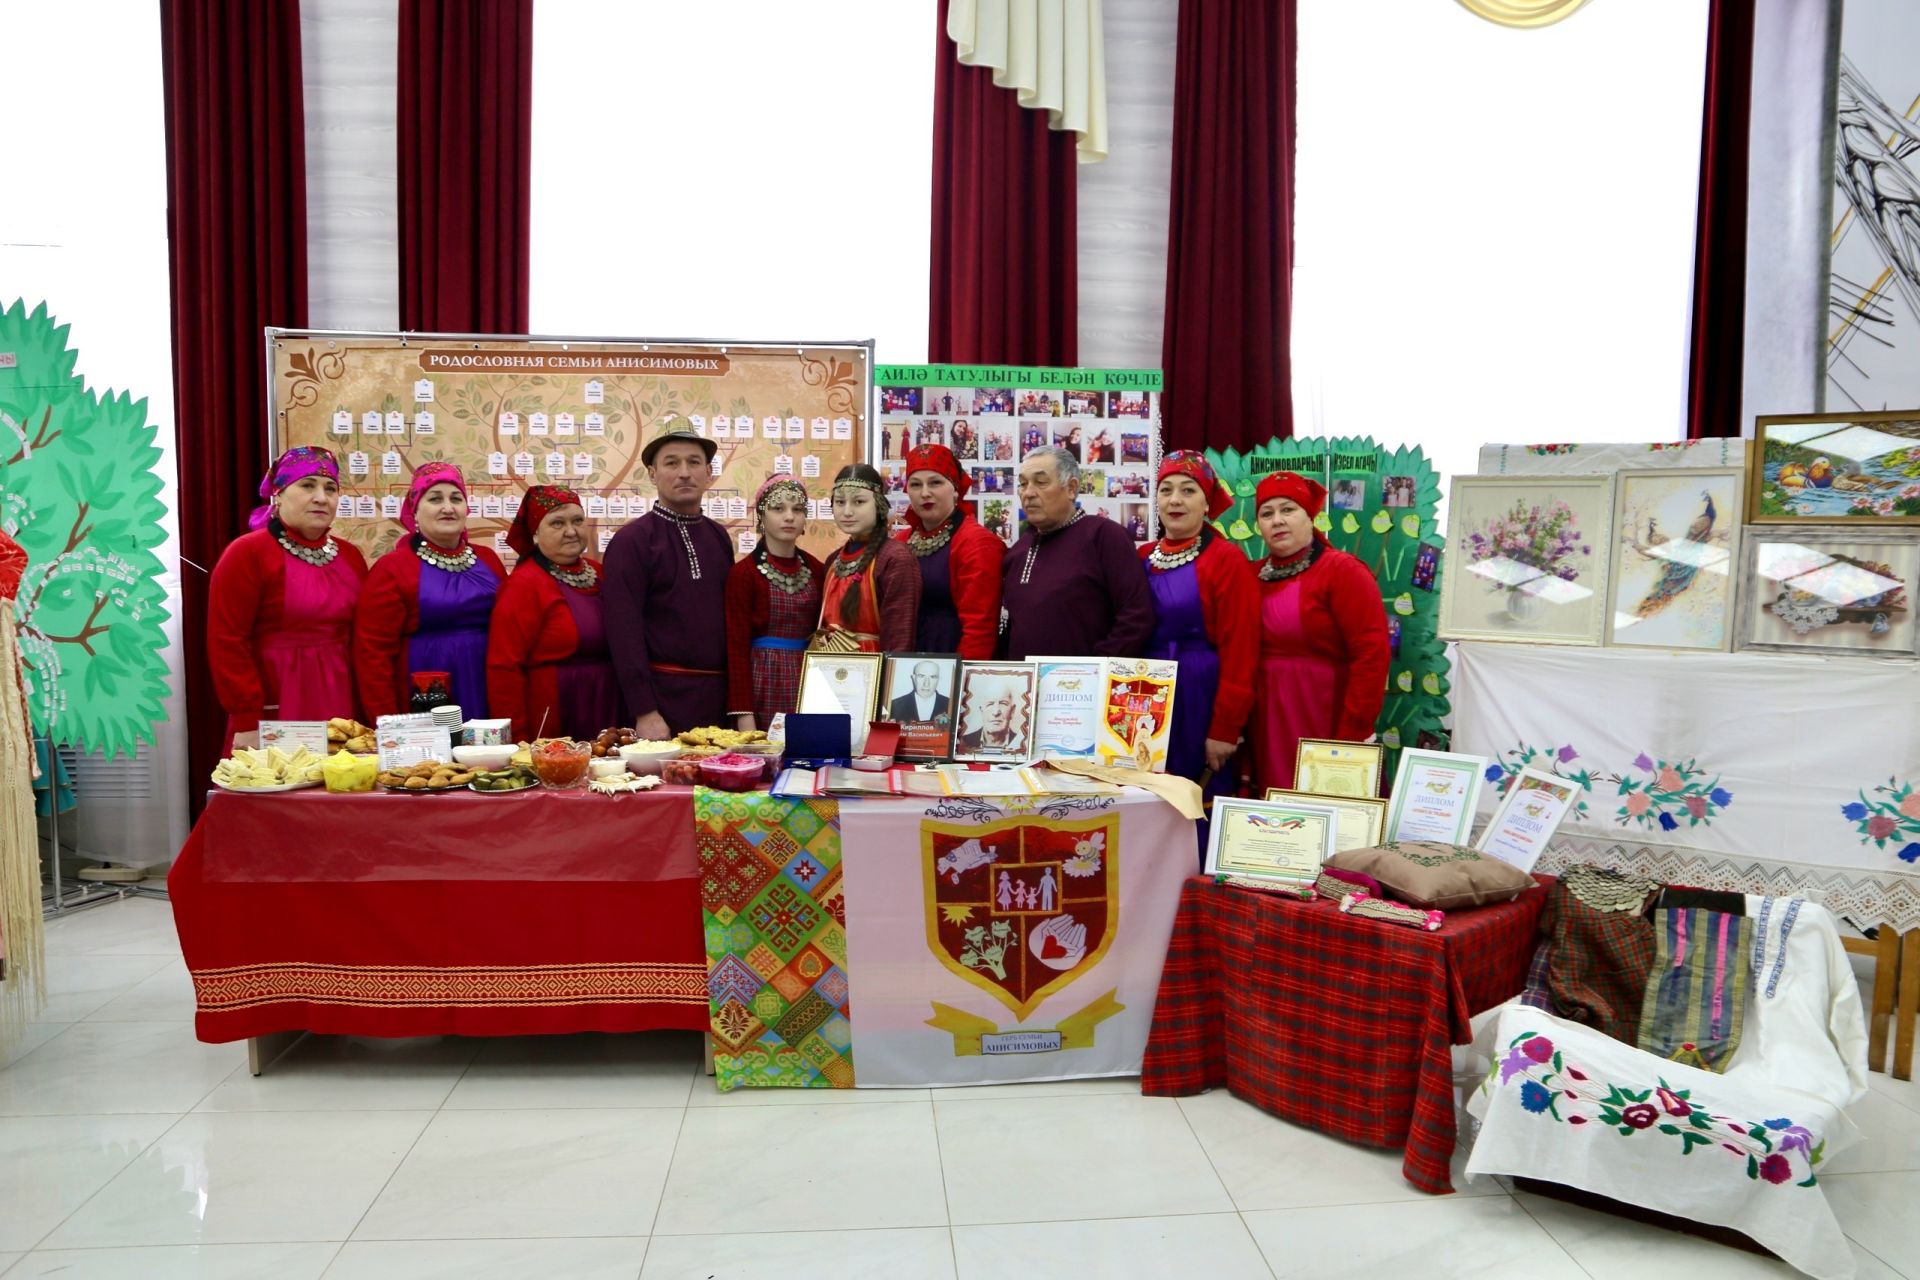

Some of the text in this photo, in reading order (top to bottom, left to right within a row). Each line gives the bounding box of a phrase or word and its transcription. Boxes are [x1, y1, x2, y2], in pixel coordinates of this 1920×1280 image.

[430, 354, 719, 370] РОДОСЛОВНАЯ СЕМЬИ АНИСИМОВЫХ
[935, 369, 1032, 383] ТАТУЛЫГЫ
[1040, 371, 1095, 385] БЕЛӘН
[1105, 373, 1161, 386] КӨЧЛЕ
[1044, 693, 1093, 703] ДИПЛОМ
[985, 1041, 1059, 1052] АНИСИМОВЫХ
